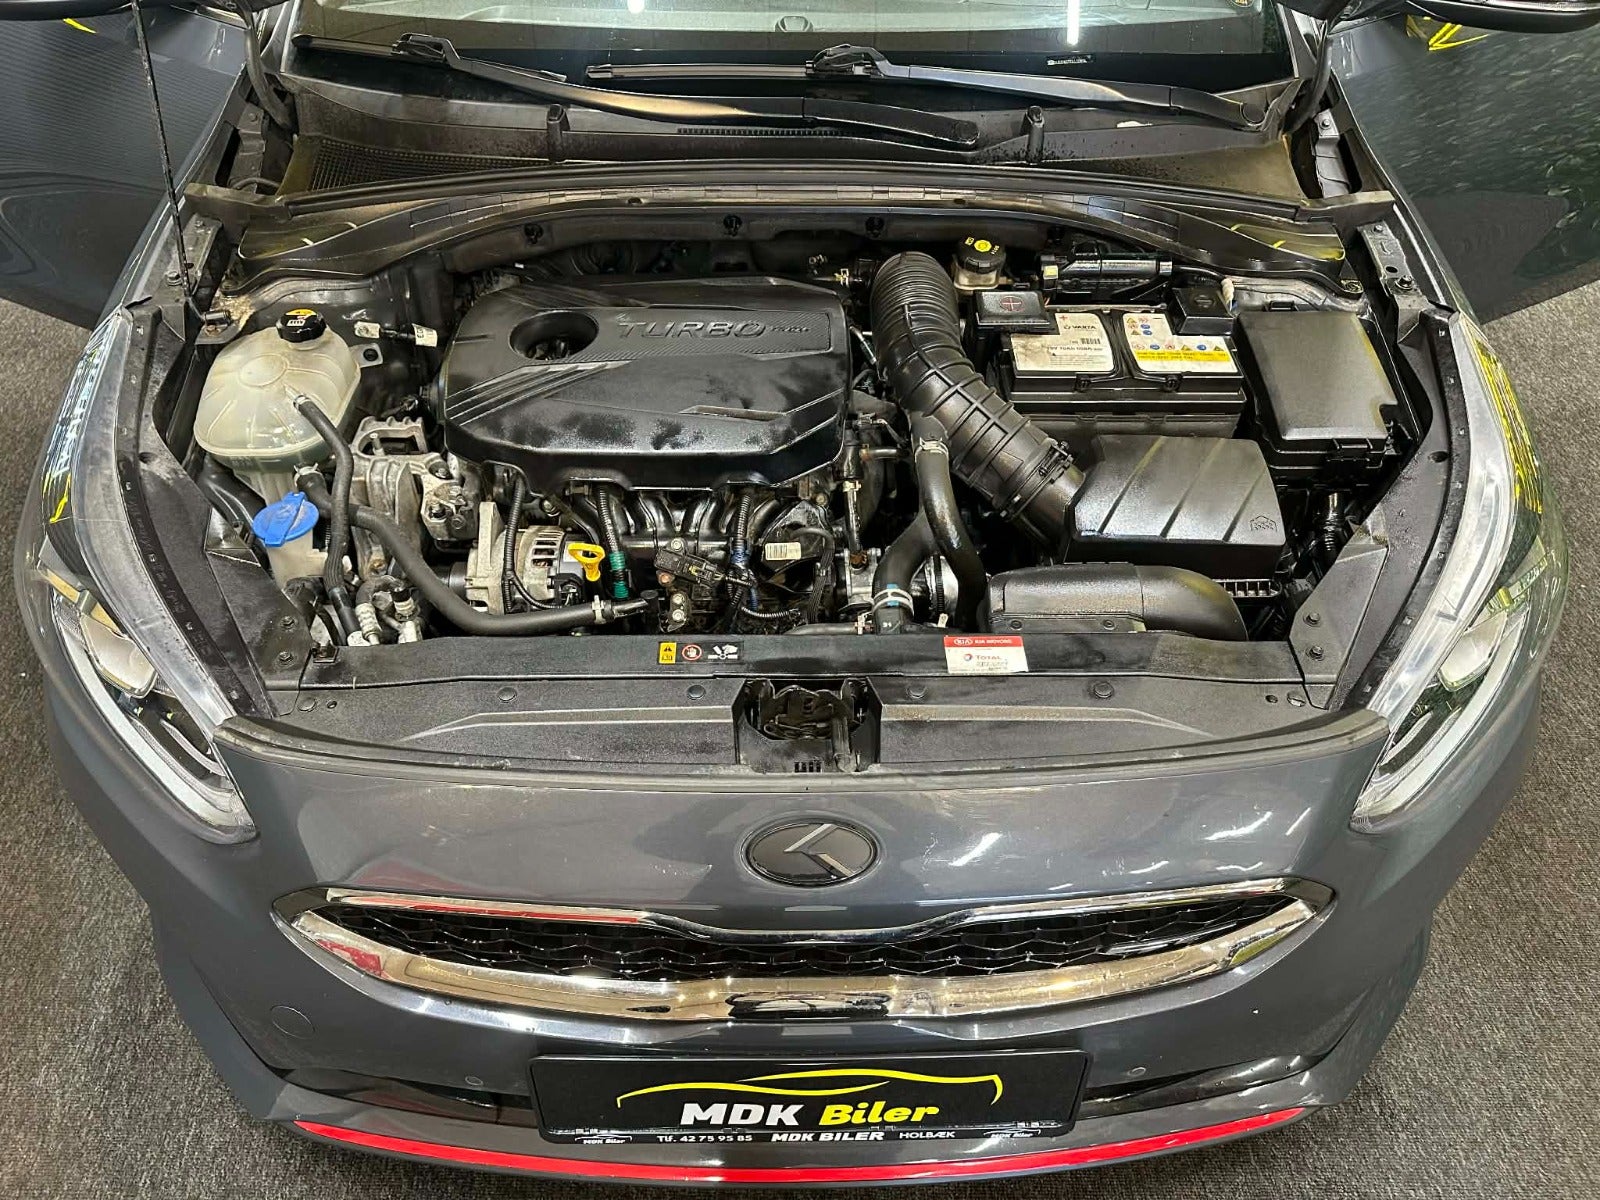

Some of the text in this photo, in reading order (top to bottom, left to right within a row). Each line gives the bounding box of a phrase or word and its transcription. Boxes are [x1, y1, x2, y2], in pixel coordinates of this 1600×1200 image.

[617, 321, 767, 339] TURBO
[680, 1100, 940, 1126] MDK Biler
[737, 1134, 753, 1142] 85
[771, 1132, 815, 1142] MDK
[818, 1131, 885, 1141] BILER
[899, 1131, 956, 1139] HOLBÆK
